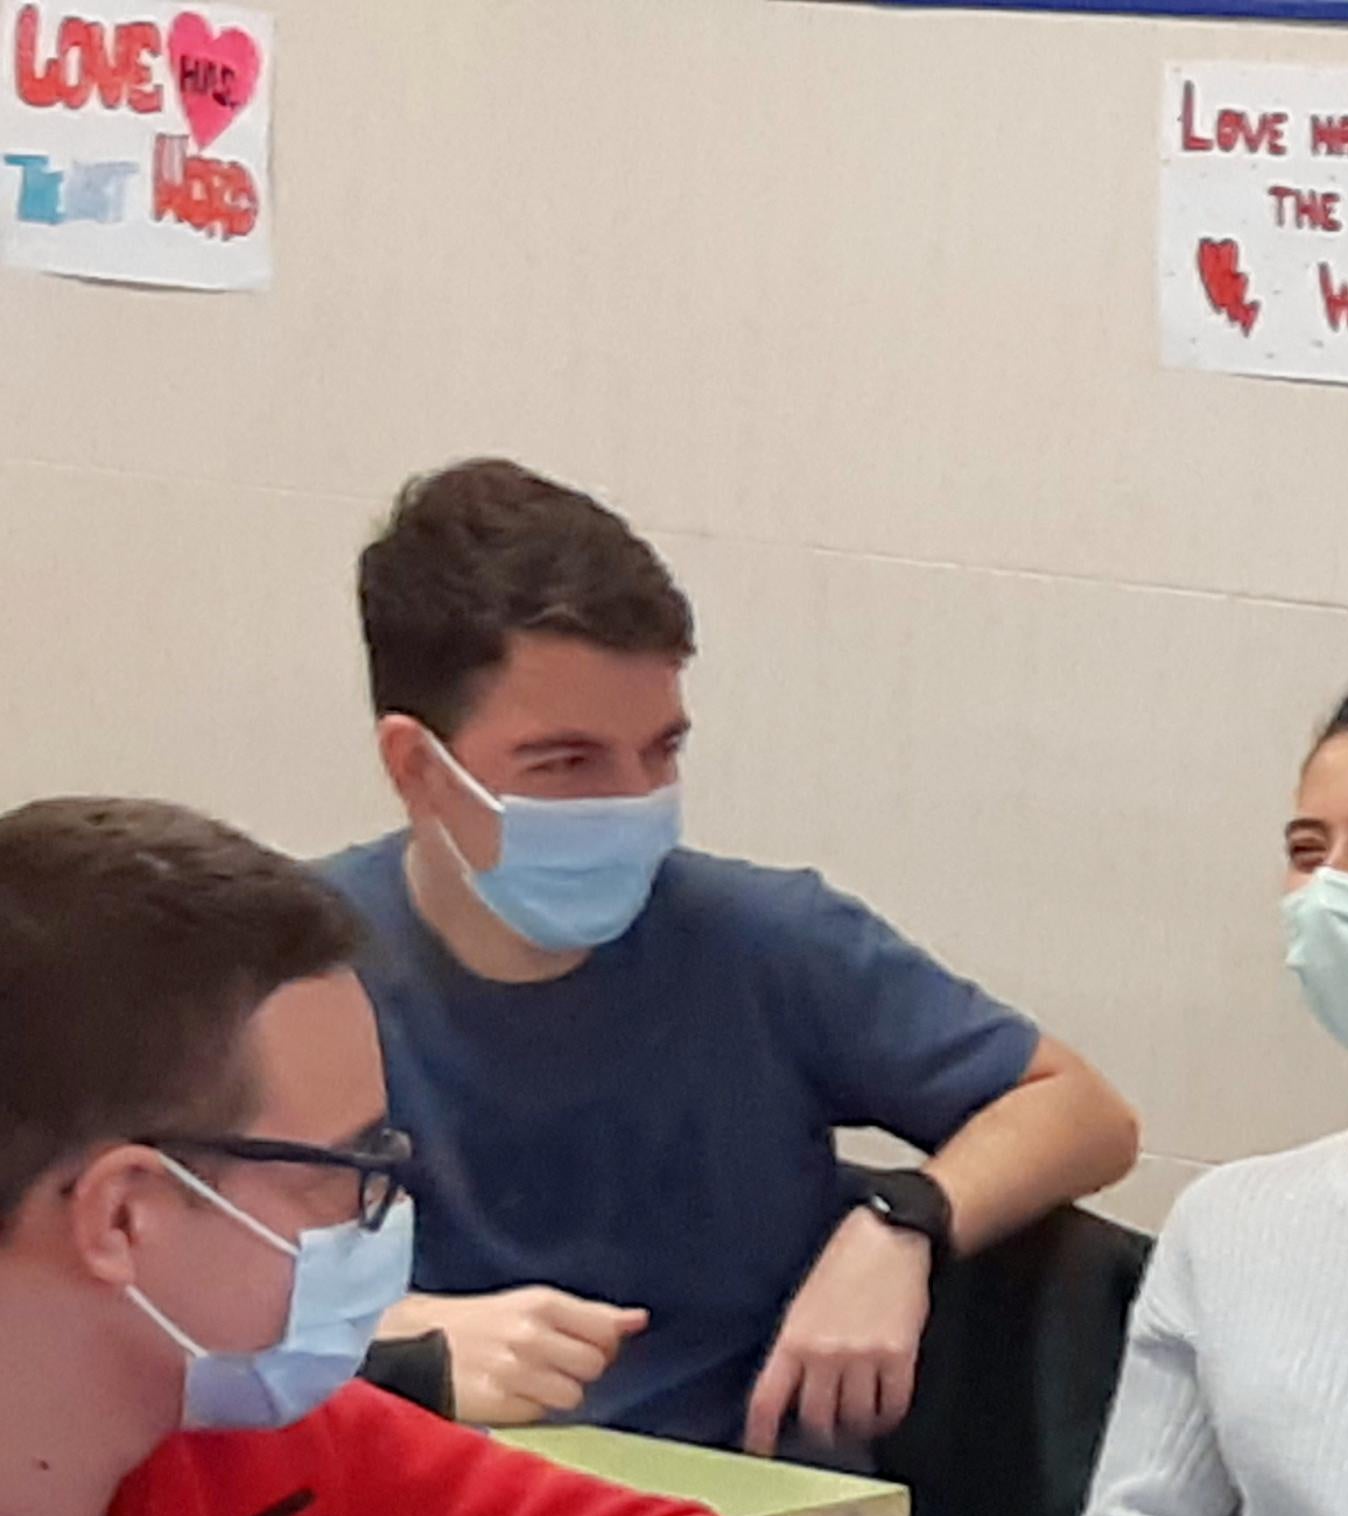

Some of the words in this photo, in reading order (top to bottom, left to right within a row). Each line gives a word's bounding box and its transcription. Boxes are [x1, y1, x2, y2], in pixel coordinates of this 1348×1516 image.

[15, 3, 164, 114] LOVE
[1181, 79, 1289, 157] LOVE
[1267, 185, 1343, 232] THE
